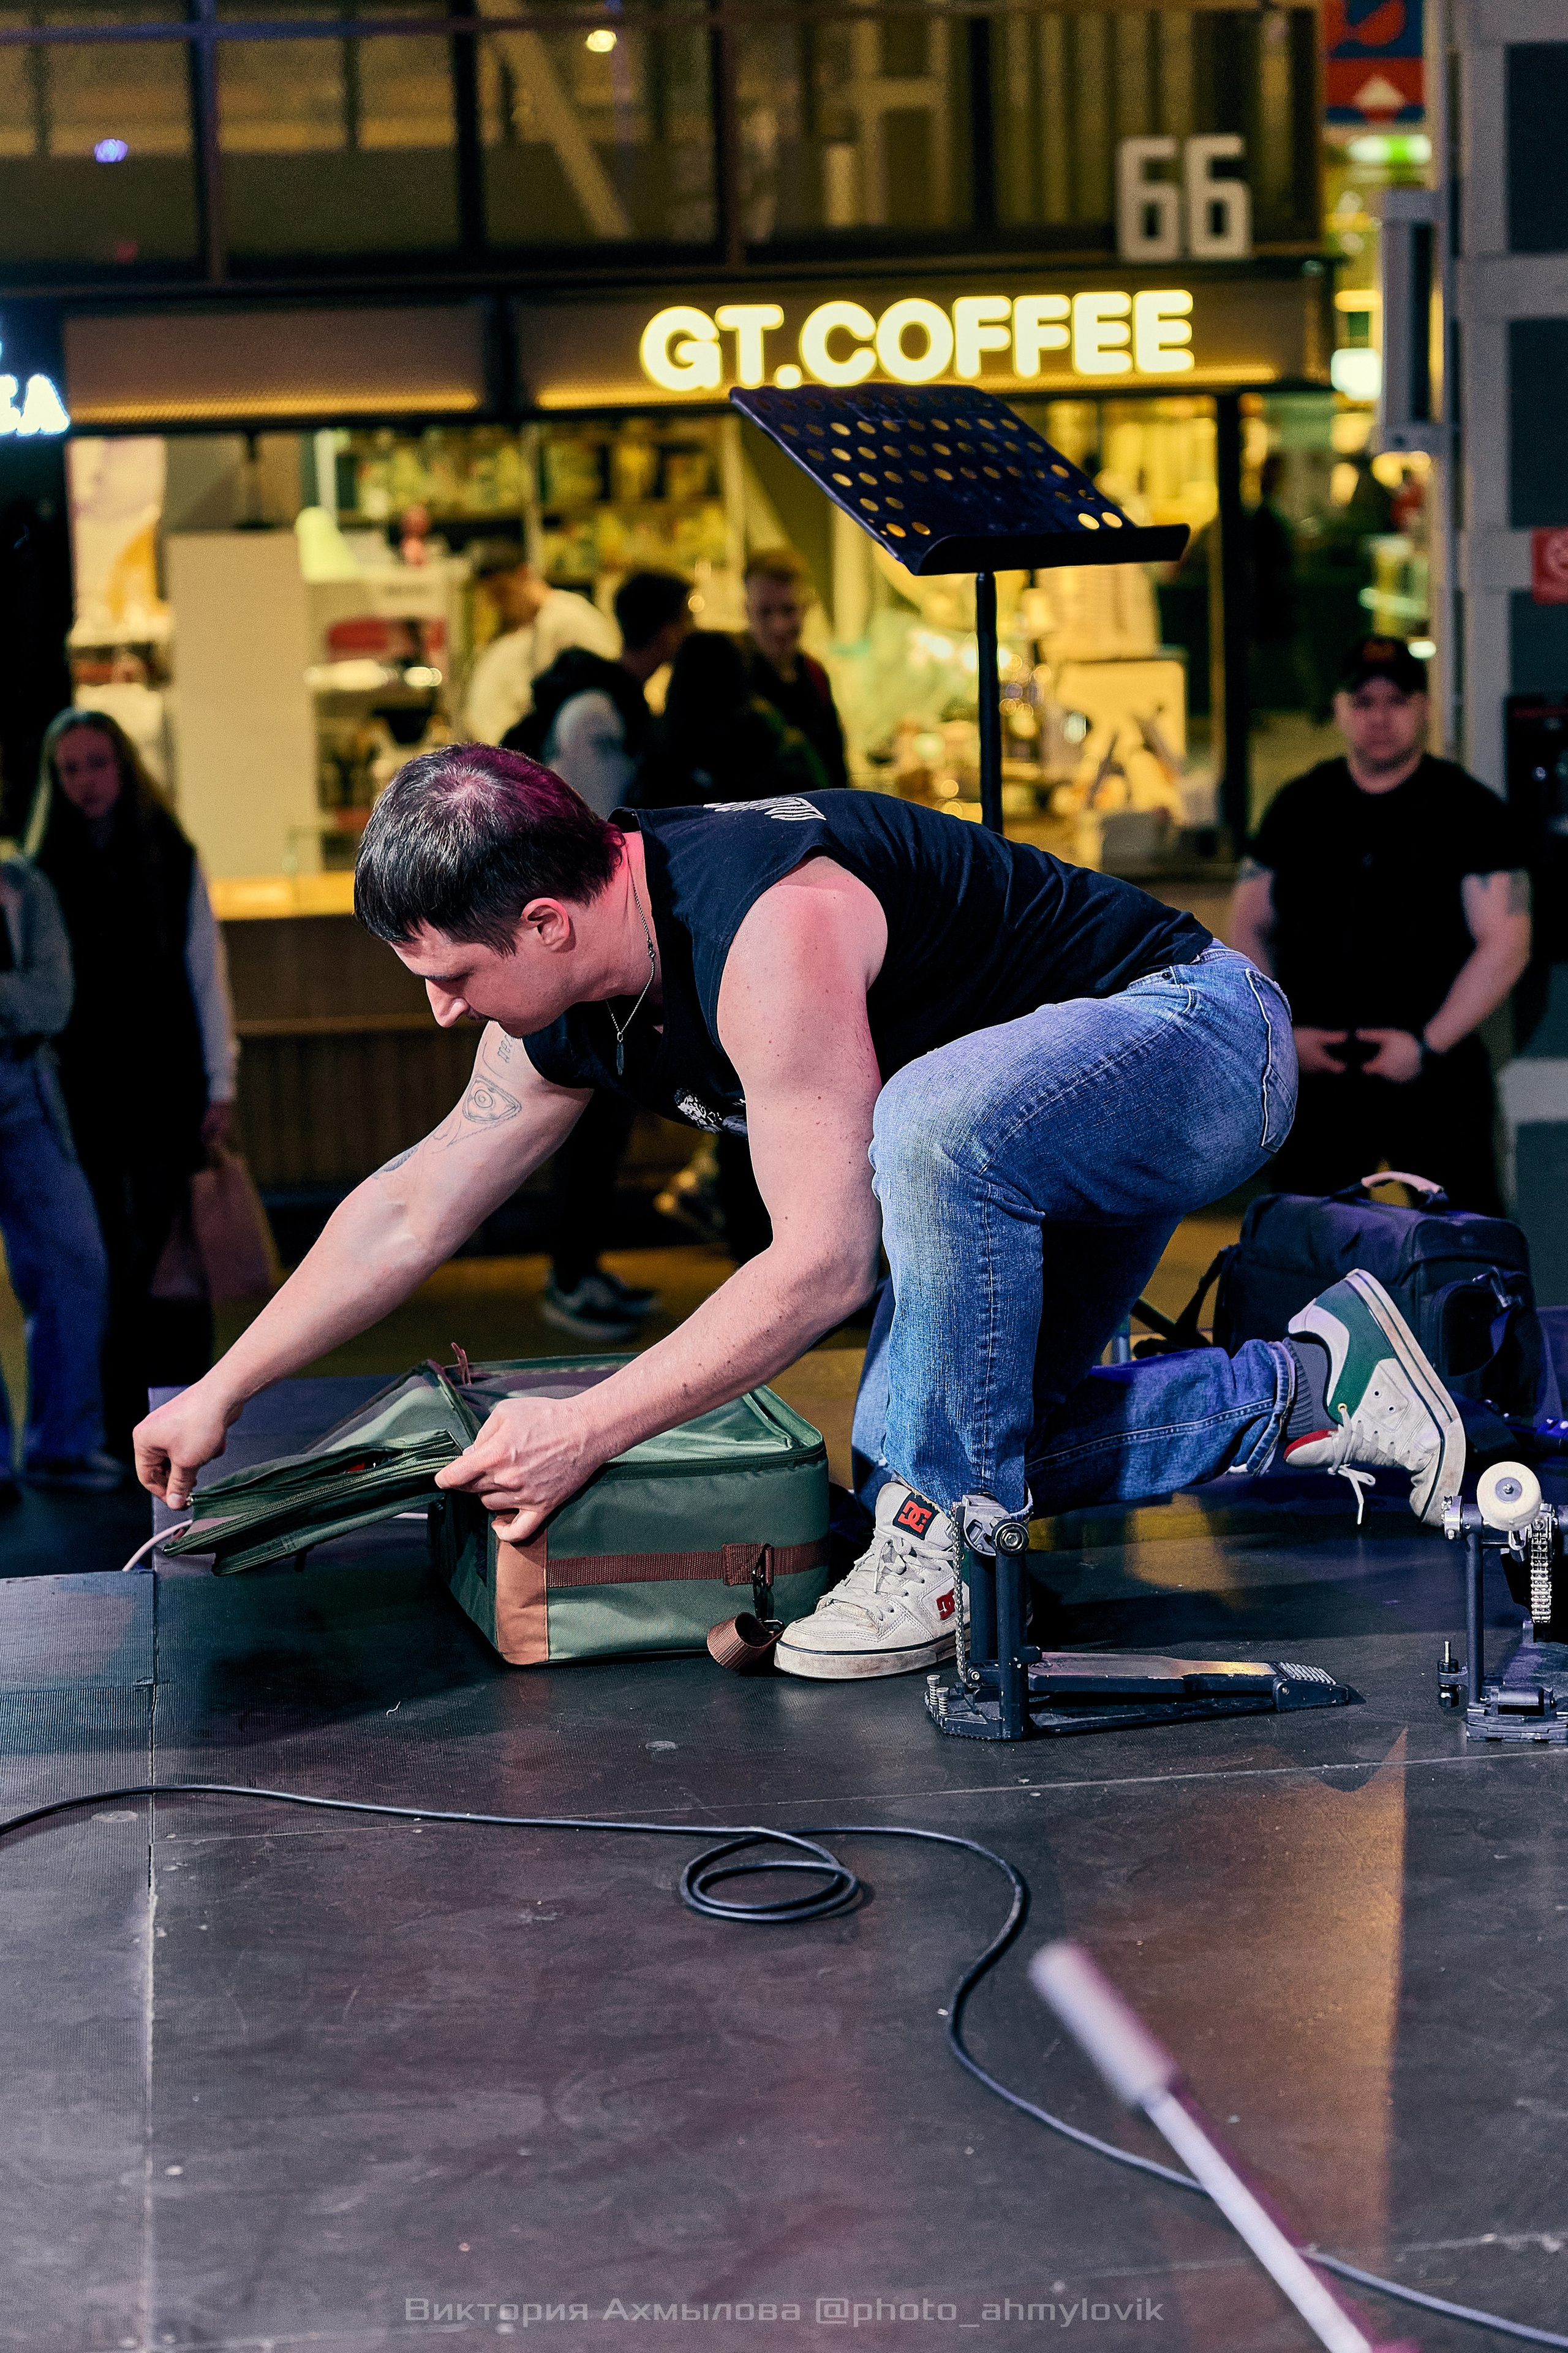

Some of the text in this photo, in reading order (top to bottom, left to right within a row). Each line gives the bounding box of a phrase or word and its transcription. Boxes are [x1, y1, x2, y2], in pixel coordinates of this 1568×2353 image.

[1118, 134, 1253, 262] 66
[640, 289, 1195, 392] GT.COFFEE
[897, 1500, 932, 1534] DC
